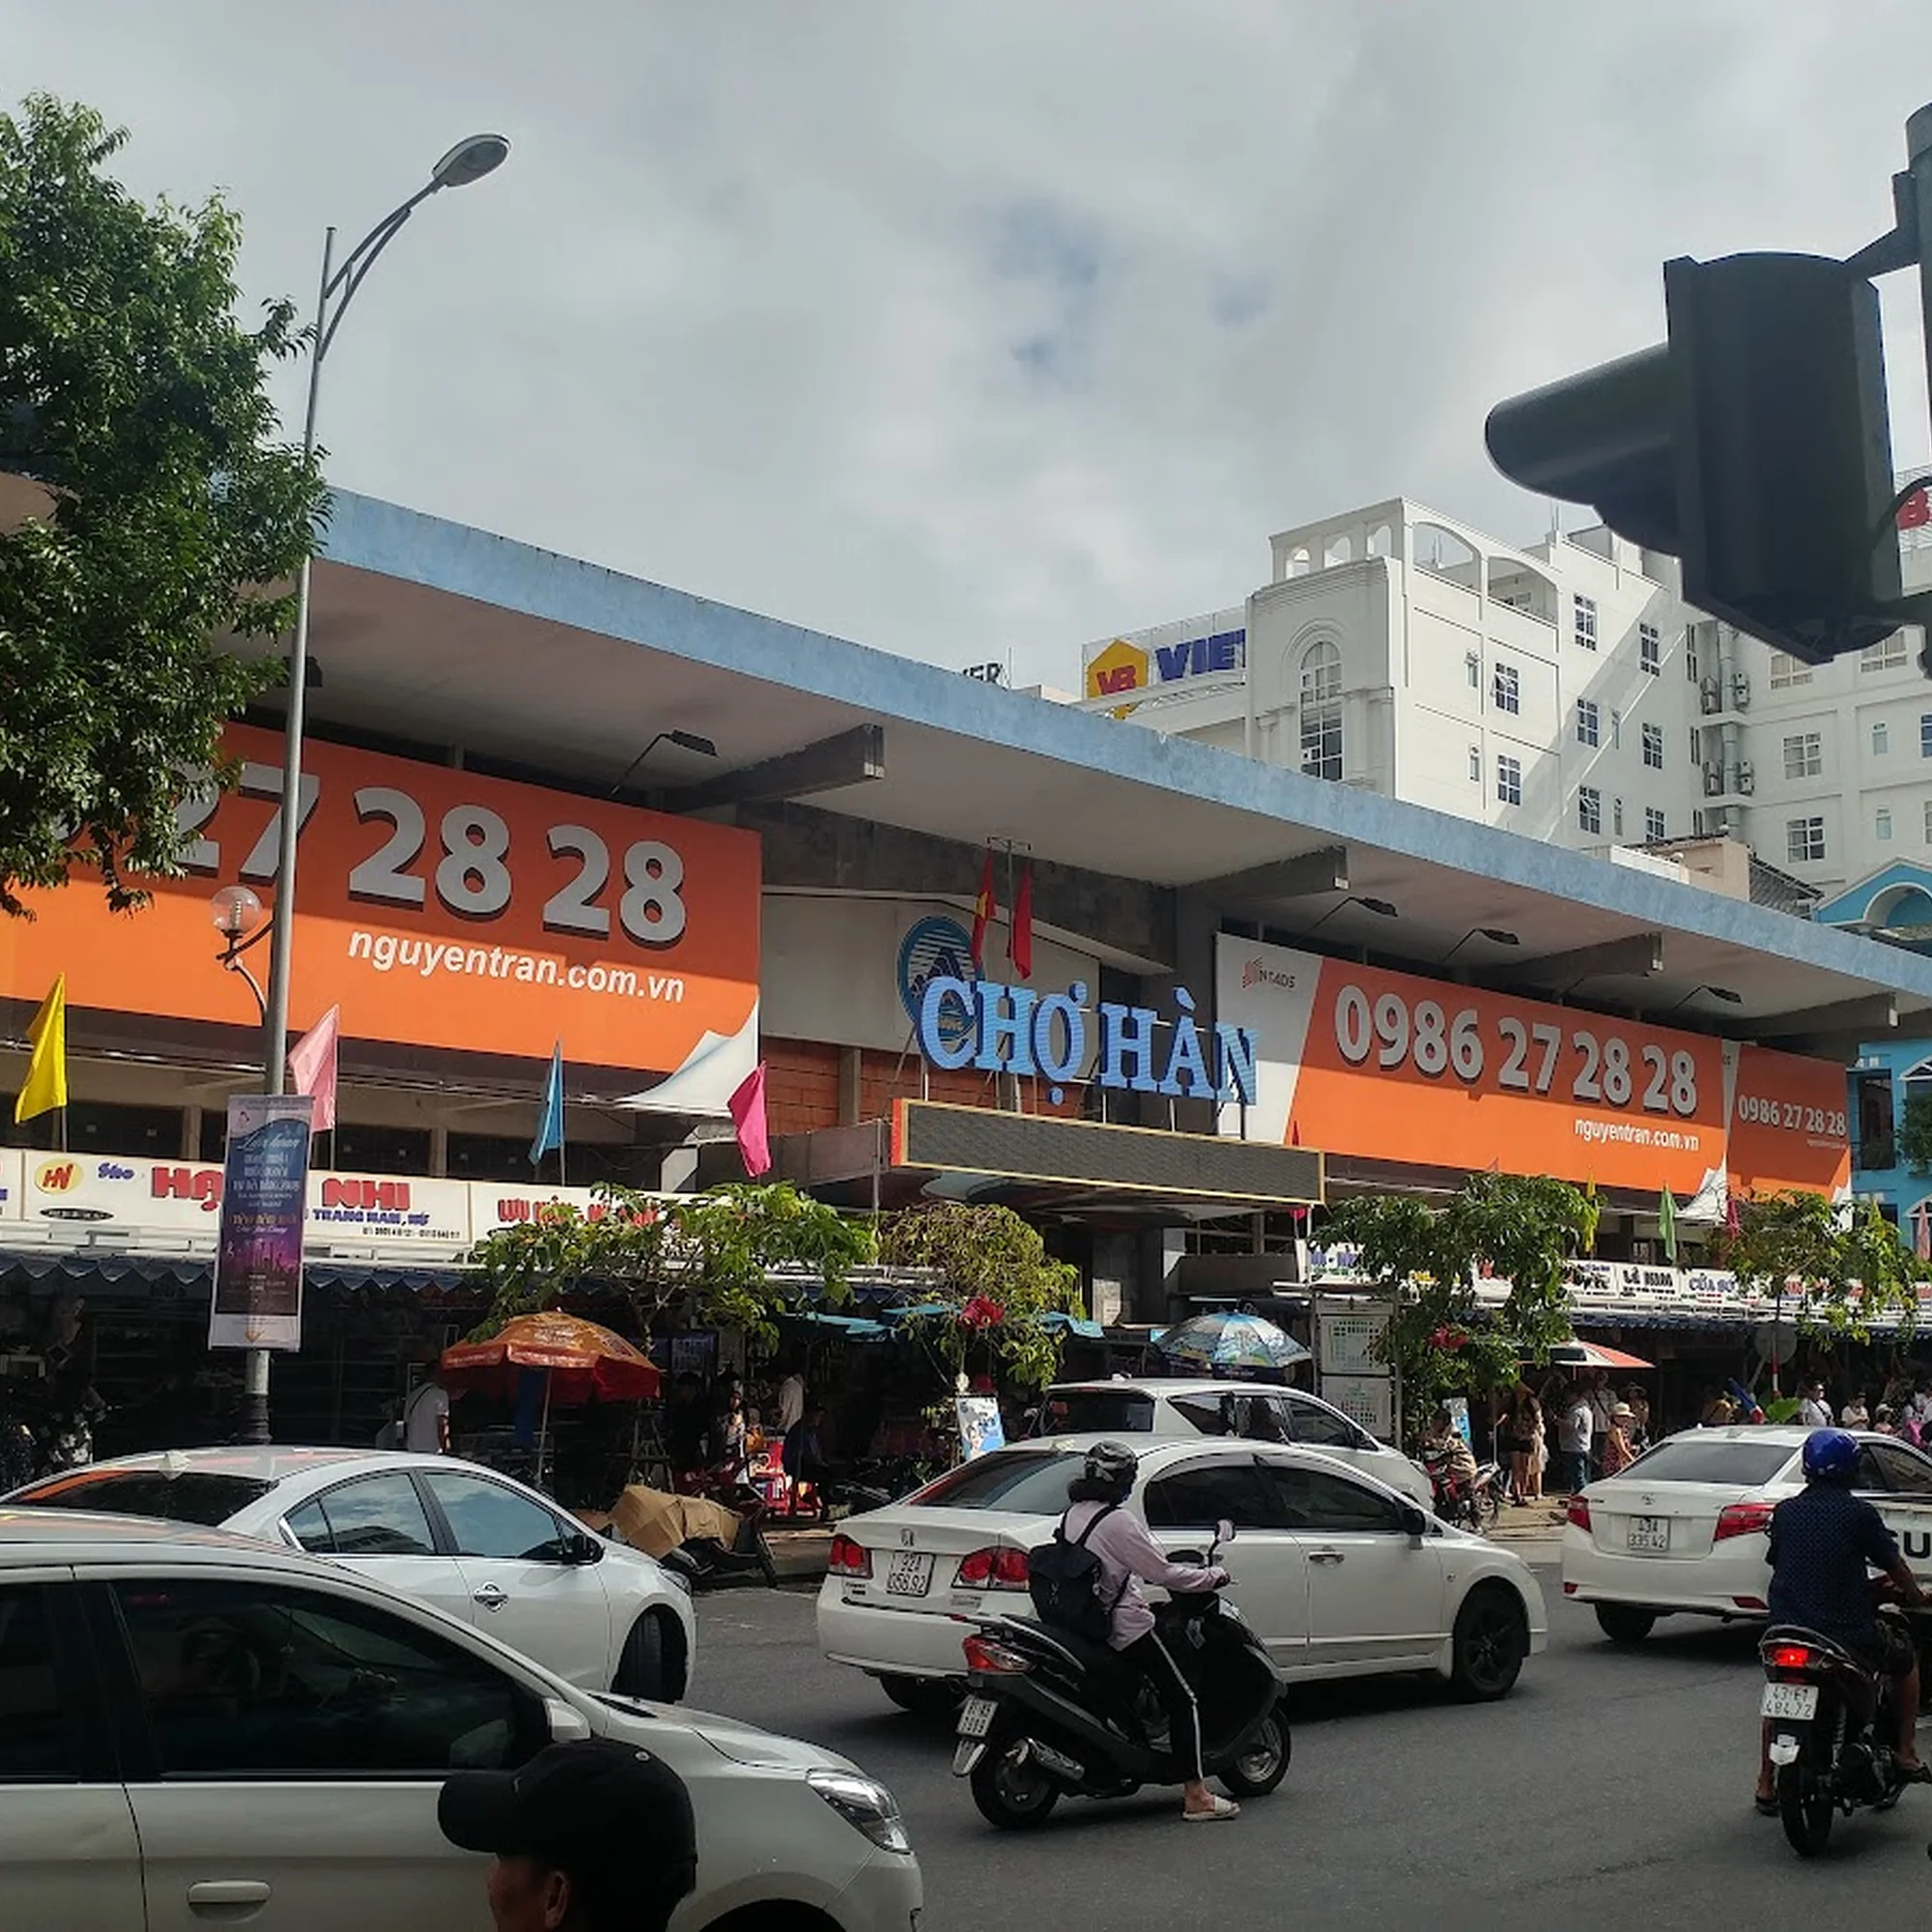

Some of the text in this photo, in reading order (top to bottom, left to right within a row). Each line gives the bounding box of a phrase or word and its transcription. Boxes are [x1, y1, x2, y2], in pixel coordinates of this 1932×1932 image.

[348, 786, 513, 921] 28
[543, 824, 687, 949] 28
[348, 929, 686, 1004] nguyentran.com.vn
[917, 976, 1259, 1106] CHỢ HÀN
[1335, 983, 1697, 1117] 0986 27 28 28
[1575, 1117, 1700, 1151] nguyentran.com.vn
[1739, 1094, 1847, 1137] 0986 27 28 28
[322, 1178, 411, 1210] NHI
